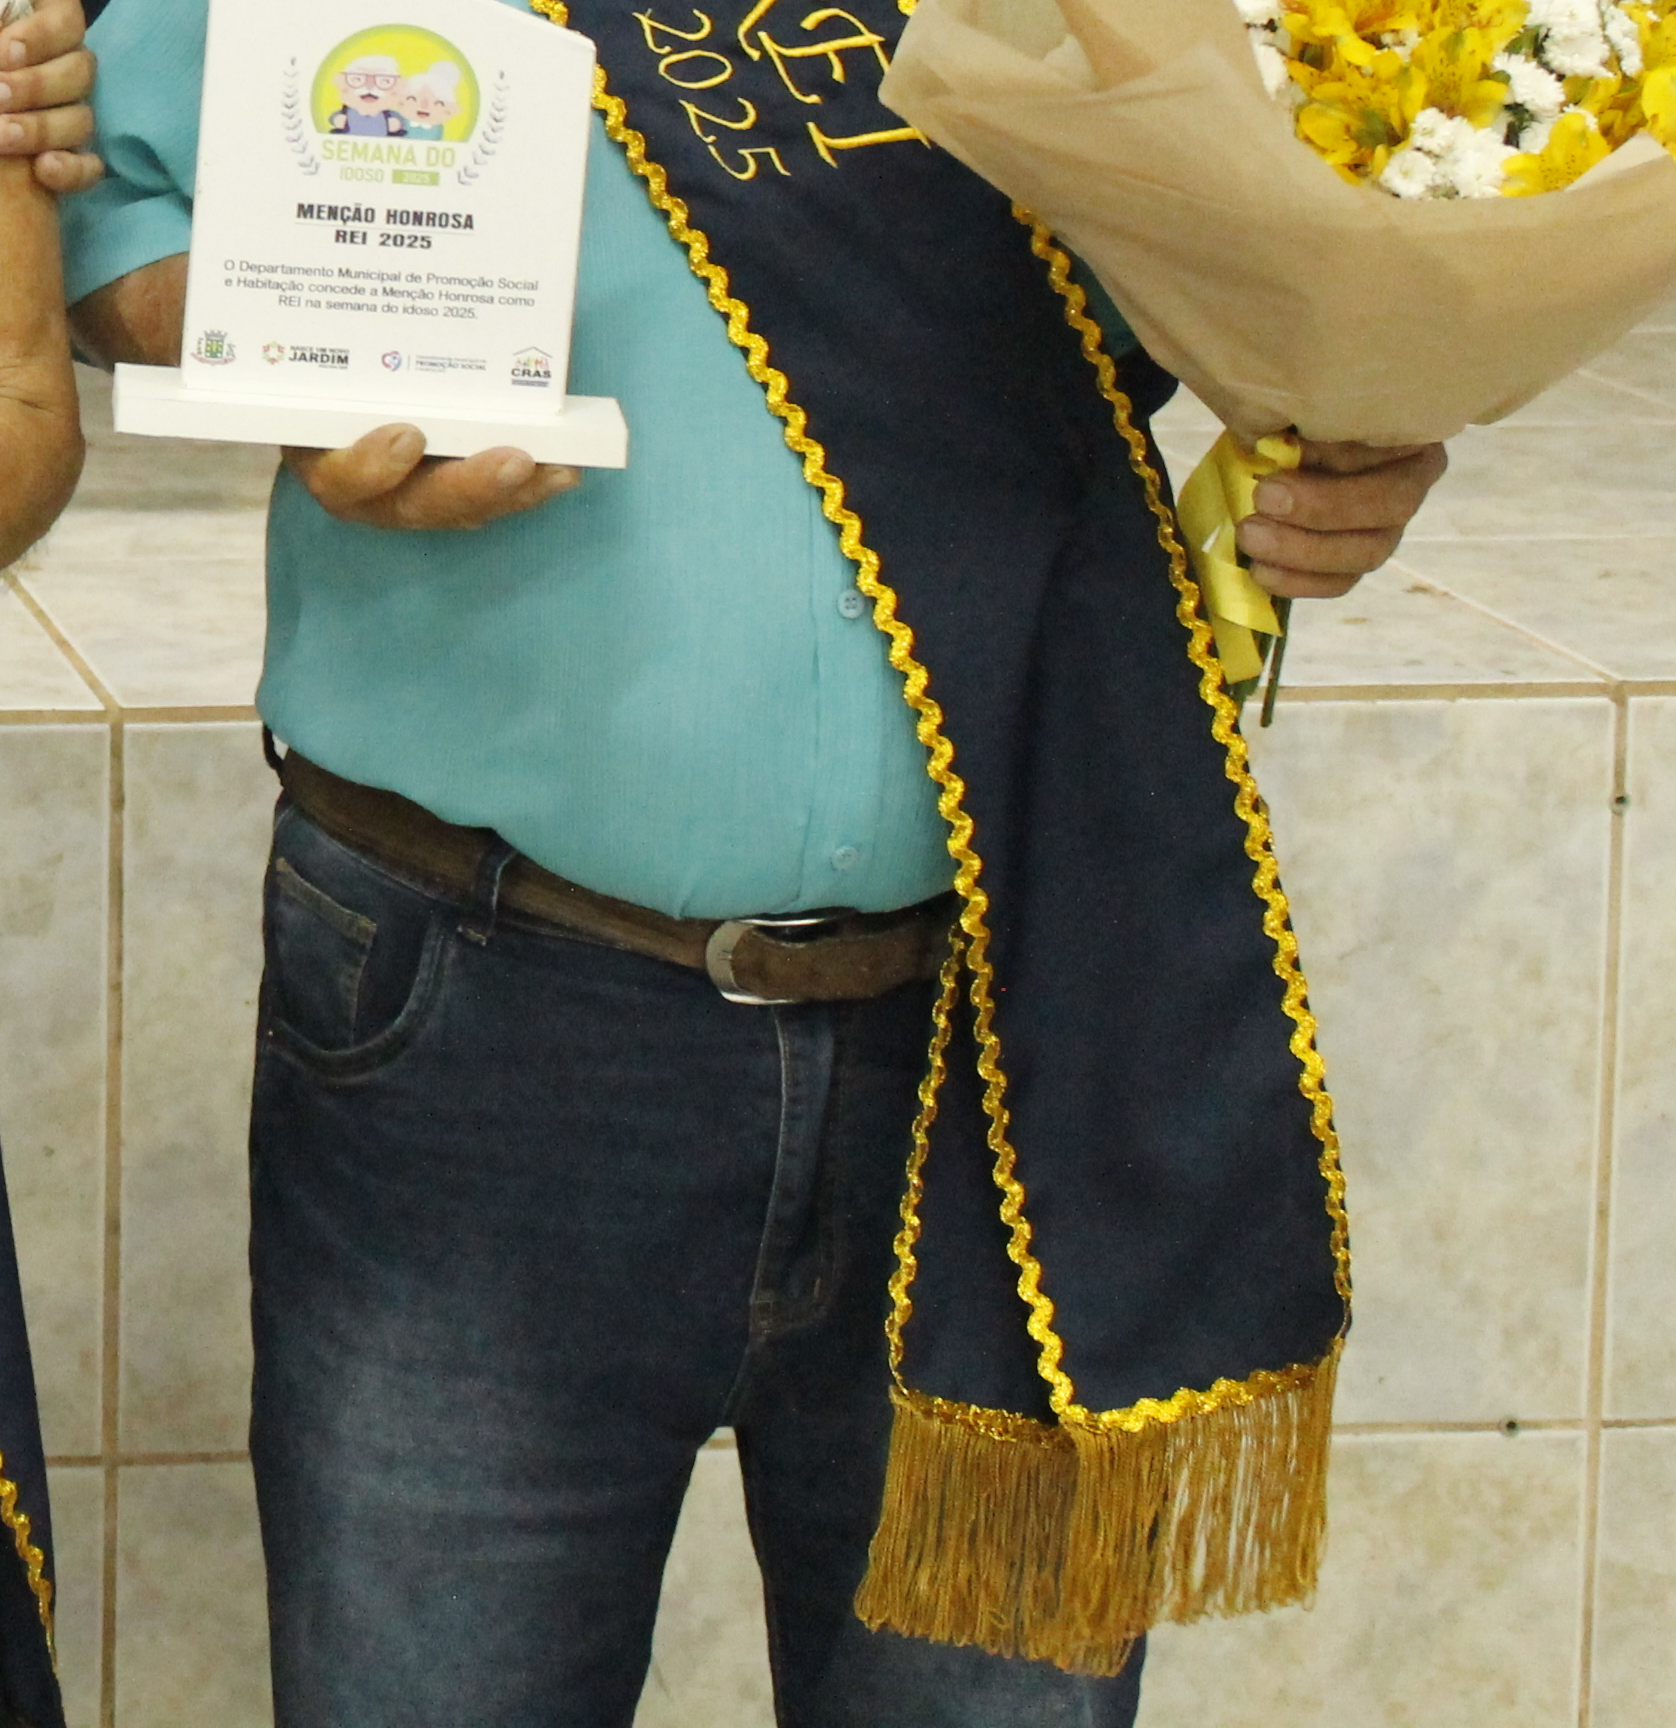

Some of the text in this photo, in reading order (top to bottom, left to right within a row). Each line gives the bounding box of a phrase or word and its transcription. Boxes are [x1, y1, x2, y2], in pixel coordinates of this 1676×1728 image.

[632, 8, 792, 181] 2025
[322, 140, 456, 168] SEMANA DO
[339, 166, 384, 183] IDOSO
[296, 202, 474, 230] MENÇÃO HONROSA
[335, 230, 432, 249] REI 2025
[224, 259, 539, 291] O Departamento Municipal de Promoção Social
[224, 276, 535, 308] e Habitação concede a Menção Honrosa como
[278, 295, 302, 308] REI
[305, 298, 322, 310] na
[326, 300, 377, 313] semana
[381, 302, 399, 315] do
[403, 303, 438, 317] idoso
[288, 351, 349, 365] JARDIM
[511, 368, 551, 379] CRAS
